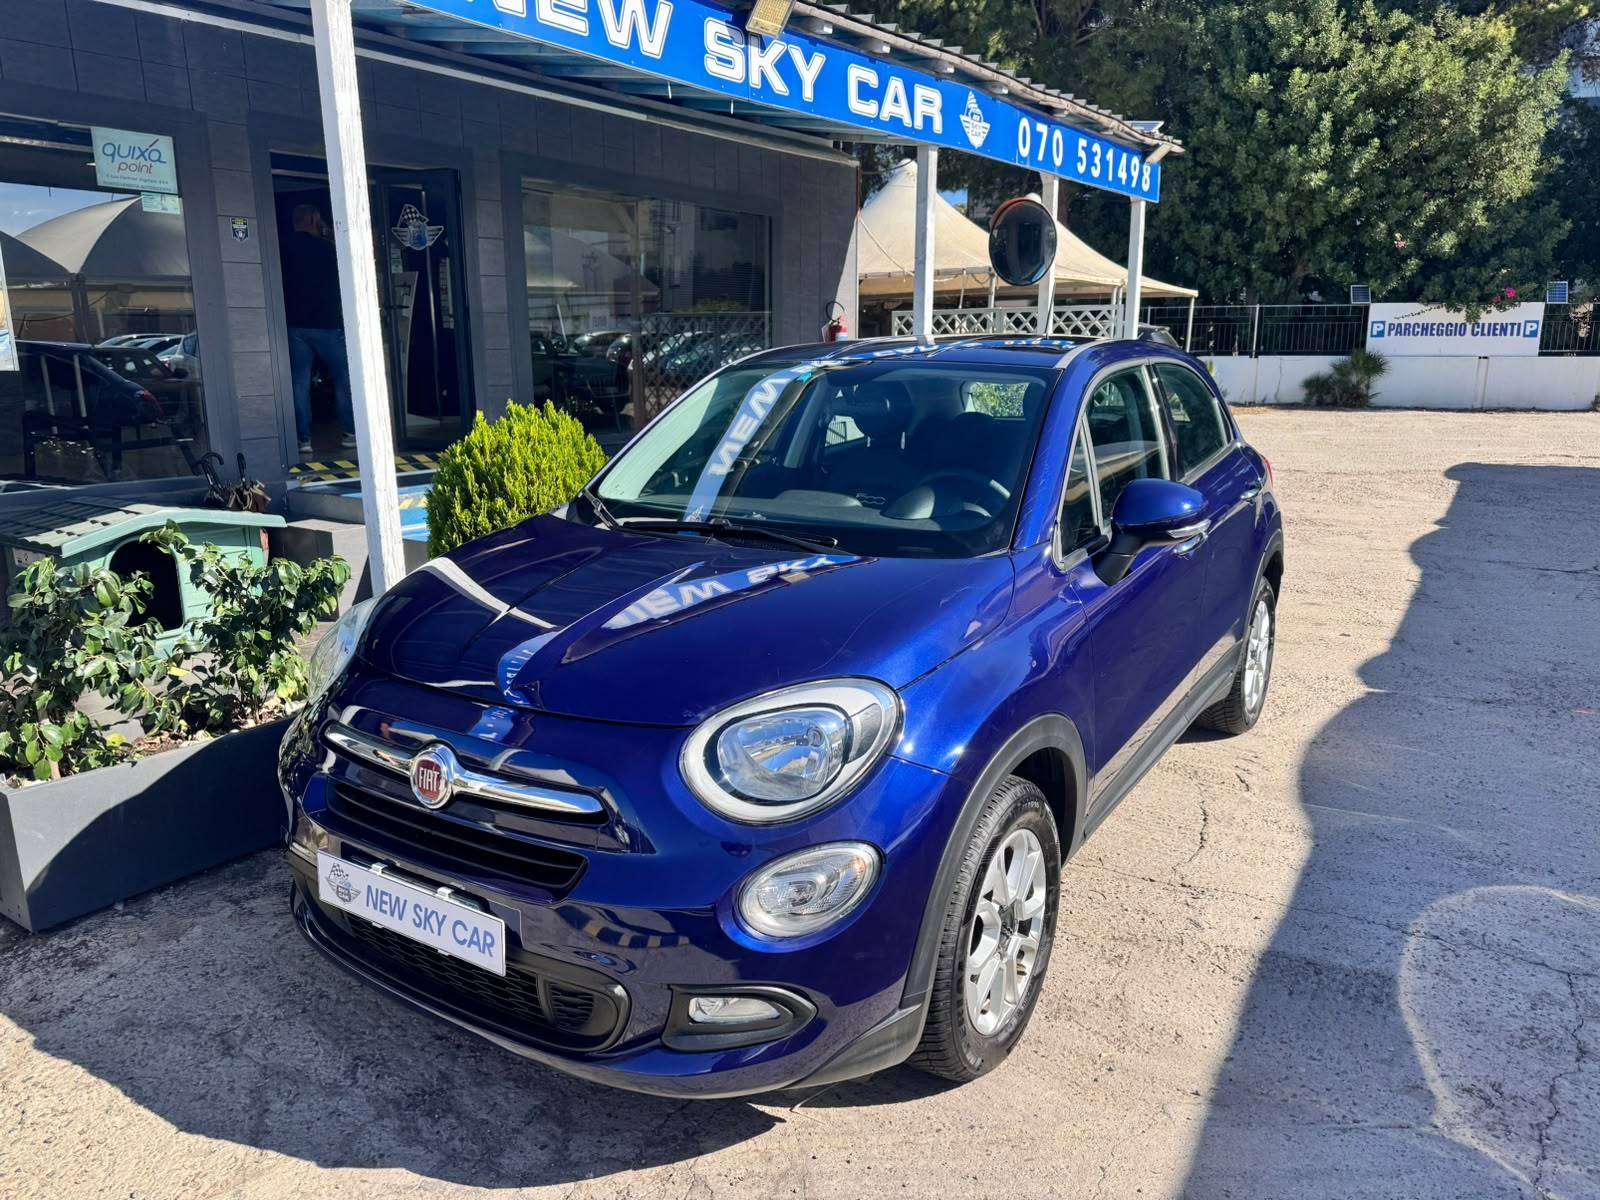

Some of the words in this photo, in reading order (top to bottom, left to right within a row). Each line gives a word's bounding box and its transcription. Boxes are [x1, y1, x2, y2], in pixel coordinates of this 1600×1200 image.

[704, 17, 826, 102] SKY
[847, 63, 943, 134] CAR
[117, 161, 154, 175] point
[1018, 117, 1063, 167] 070
[1076, 137, 1150, 192] 531498
[1371, 321, 1385, 336] P
[1387, 322, 1467, 337] PARCHEGGIO
[1471, 322, 1522, 337] CLIENTI
[1525, 321, 1539, 336] P
[418, 767, 440, 792] FIAT
[366, 885, 408, 921] NEW
[412, 903, 447, 936] SKY
[452, 919, 495, 957] CAR
